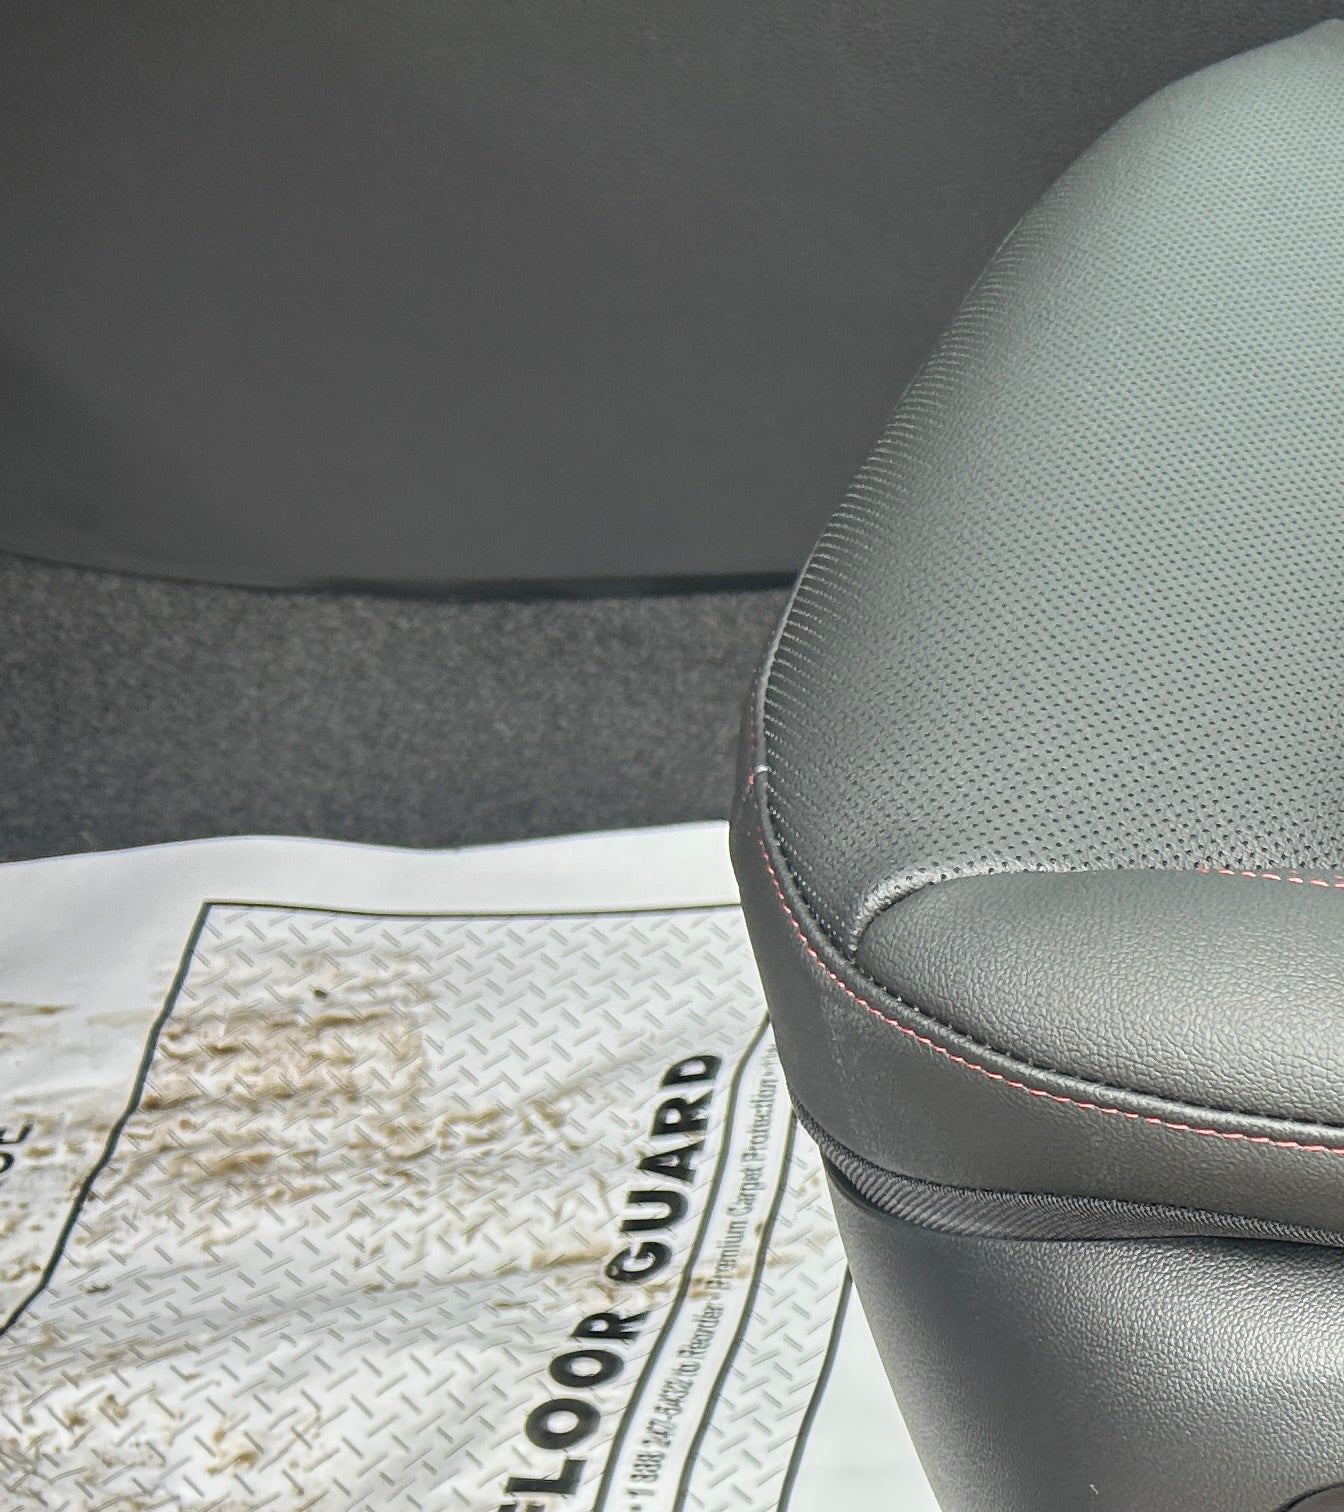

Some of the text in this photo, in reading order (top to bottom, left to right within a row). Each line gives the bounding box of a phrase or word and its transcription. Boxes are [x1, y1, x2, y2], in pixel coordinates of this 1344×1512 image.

[741, 1078, 779, 1164] Protection
[604, 1054, 723, 1284] GUARD
[727, 1166, 766, 1217] Carpet
[705, 1218, 749, 1290] Premium
[677, 1303, 725, 1361] Reorder
[670, 1359, 701, 1380] to
[630, 1450, 665, 1483] 888
